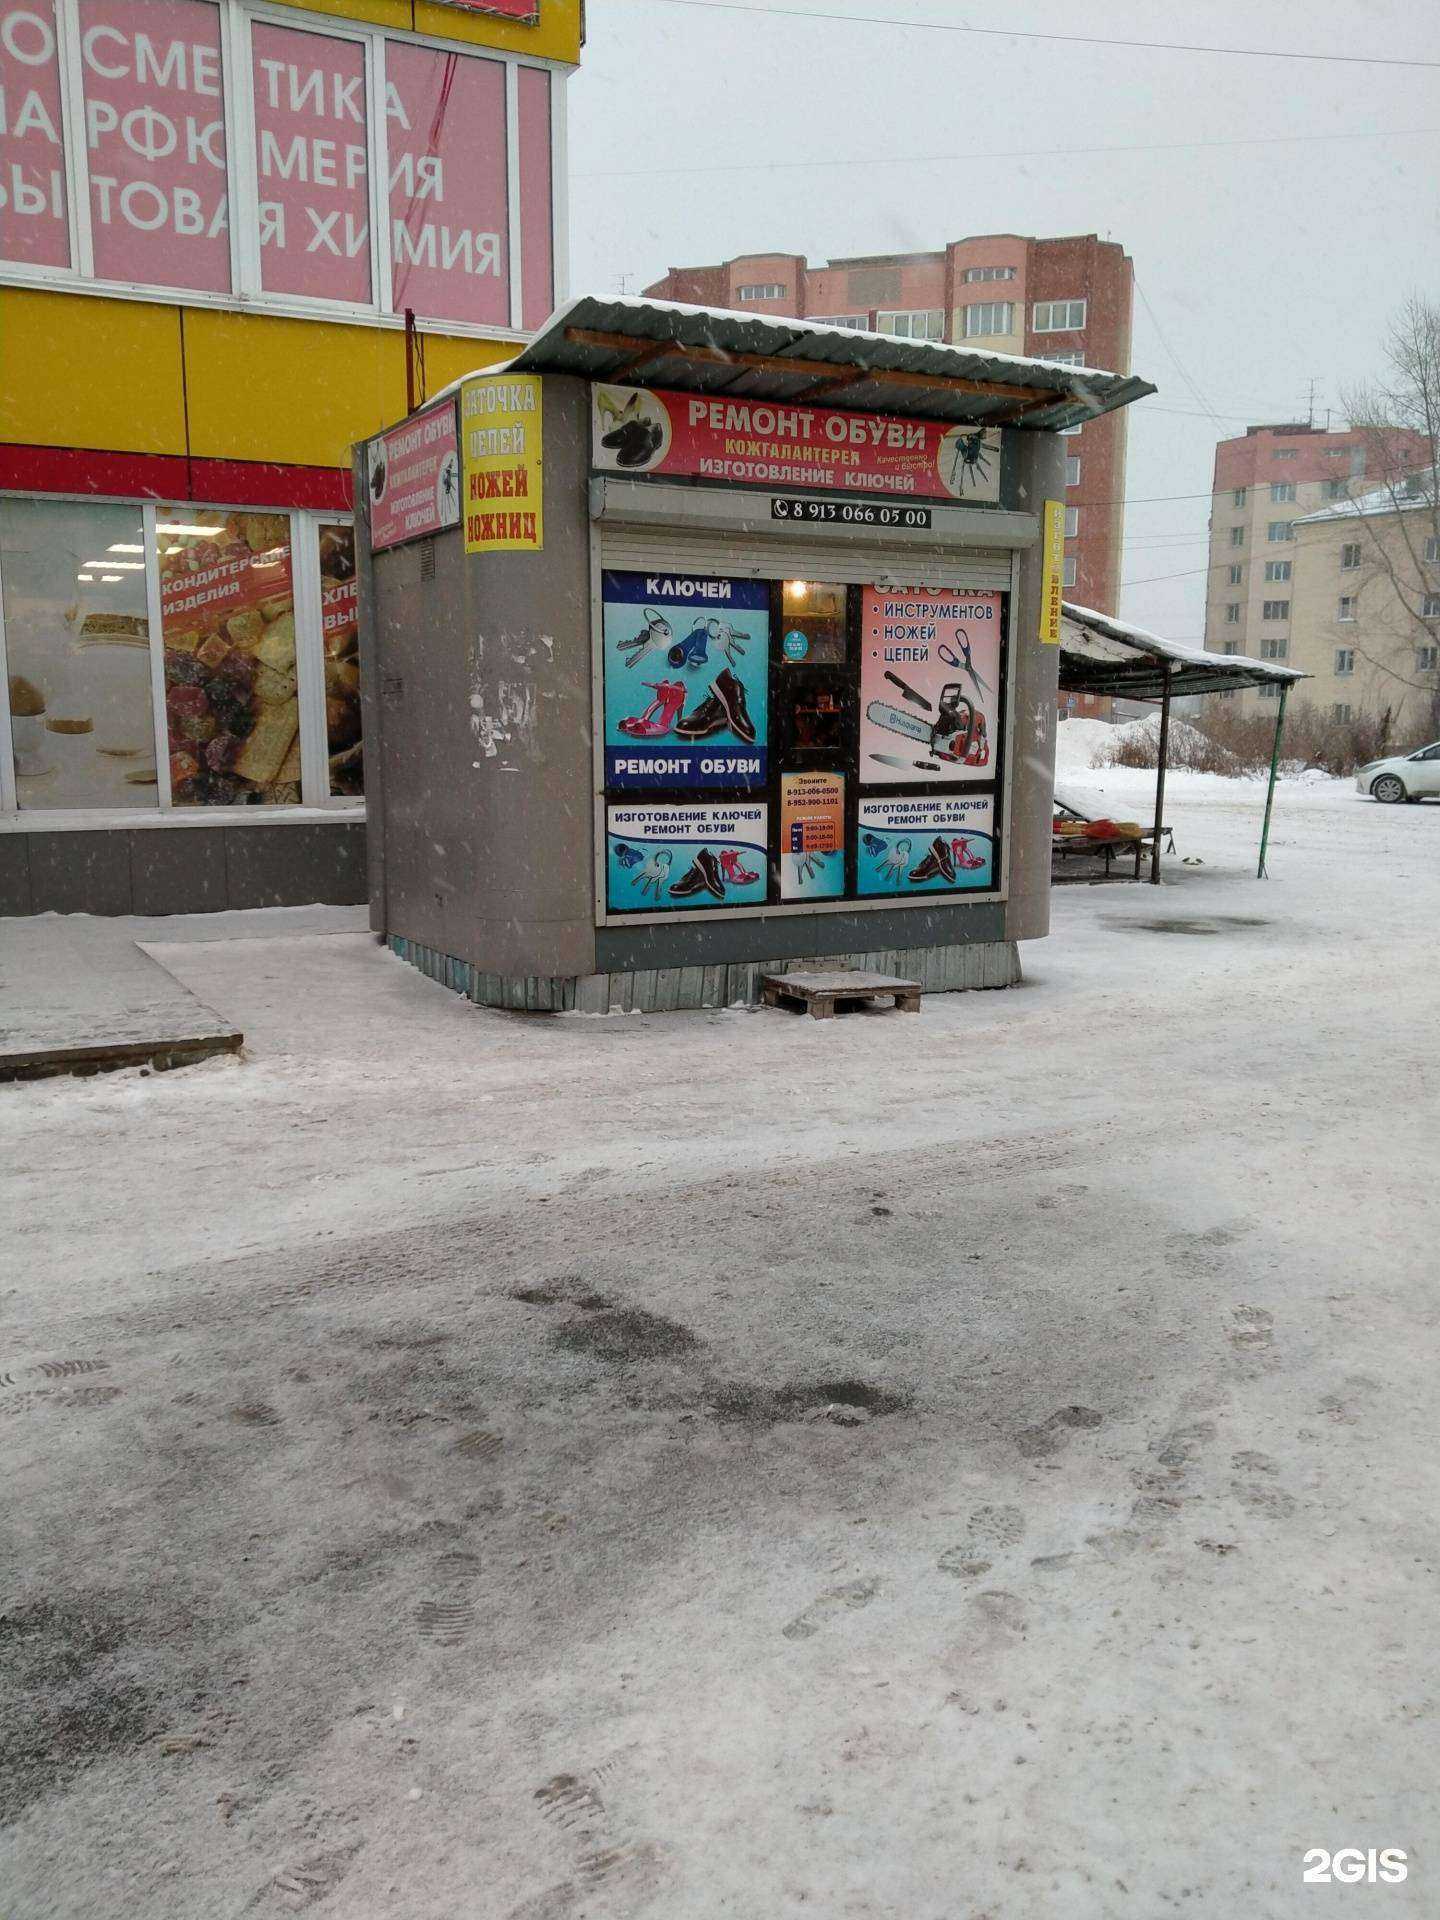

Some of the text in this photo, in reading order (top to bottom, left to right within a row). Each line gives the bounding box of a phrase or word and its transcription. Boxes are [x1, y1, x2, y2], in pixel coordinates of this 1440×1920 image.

[0, 84, 444, 202] АРФЮМЕРИЯ
[0, 163, 499, 277] ЫТОВАЯ ХИМИЯ
[689, 400, 926, 450] РЕМОНТ ОБУВИ
[725, 438, 861, 466] КОЖГАЛАНТЕРЕЯ
[470, 464, 529, 501] НОЖЕЙ
[699, 457, 915, 491] ИЗГОТОВЛЕНИЕ КЛЮЧЕЙ
[793, 502, 927, 526] 8 913 066 05 00
[467, 511, 538, 544] НОЖНИЦ
[163, 581, 240, 617] ИЗДЕЛИЯ
[646, 579, 732, 599] КЛЮЧЕЙ
[884, 602, 993, 620] ИНСТРУМЕНТОВ
[884, 623, 936, 640] НОЖЕЙ
[884, 645, 929, 663] ЦЕПЕЙ
[614, 758, 761, 775] РЕМОНТ ОБУВИ
[615, 808, 762, 823] ИЗГОТОВЛЕНИЕ КЛЮЧЕЙ
[863, 799, 989, 815] ИЗГОТОВЛЕНИЕ КЛЮЧЕЙ
[644, 823, 735, 835] РЕМОНТ ОБУВИ
[887, 813, 966, 825] РЕМОНТ ОБУВИ
